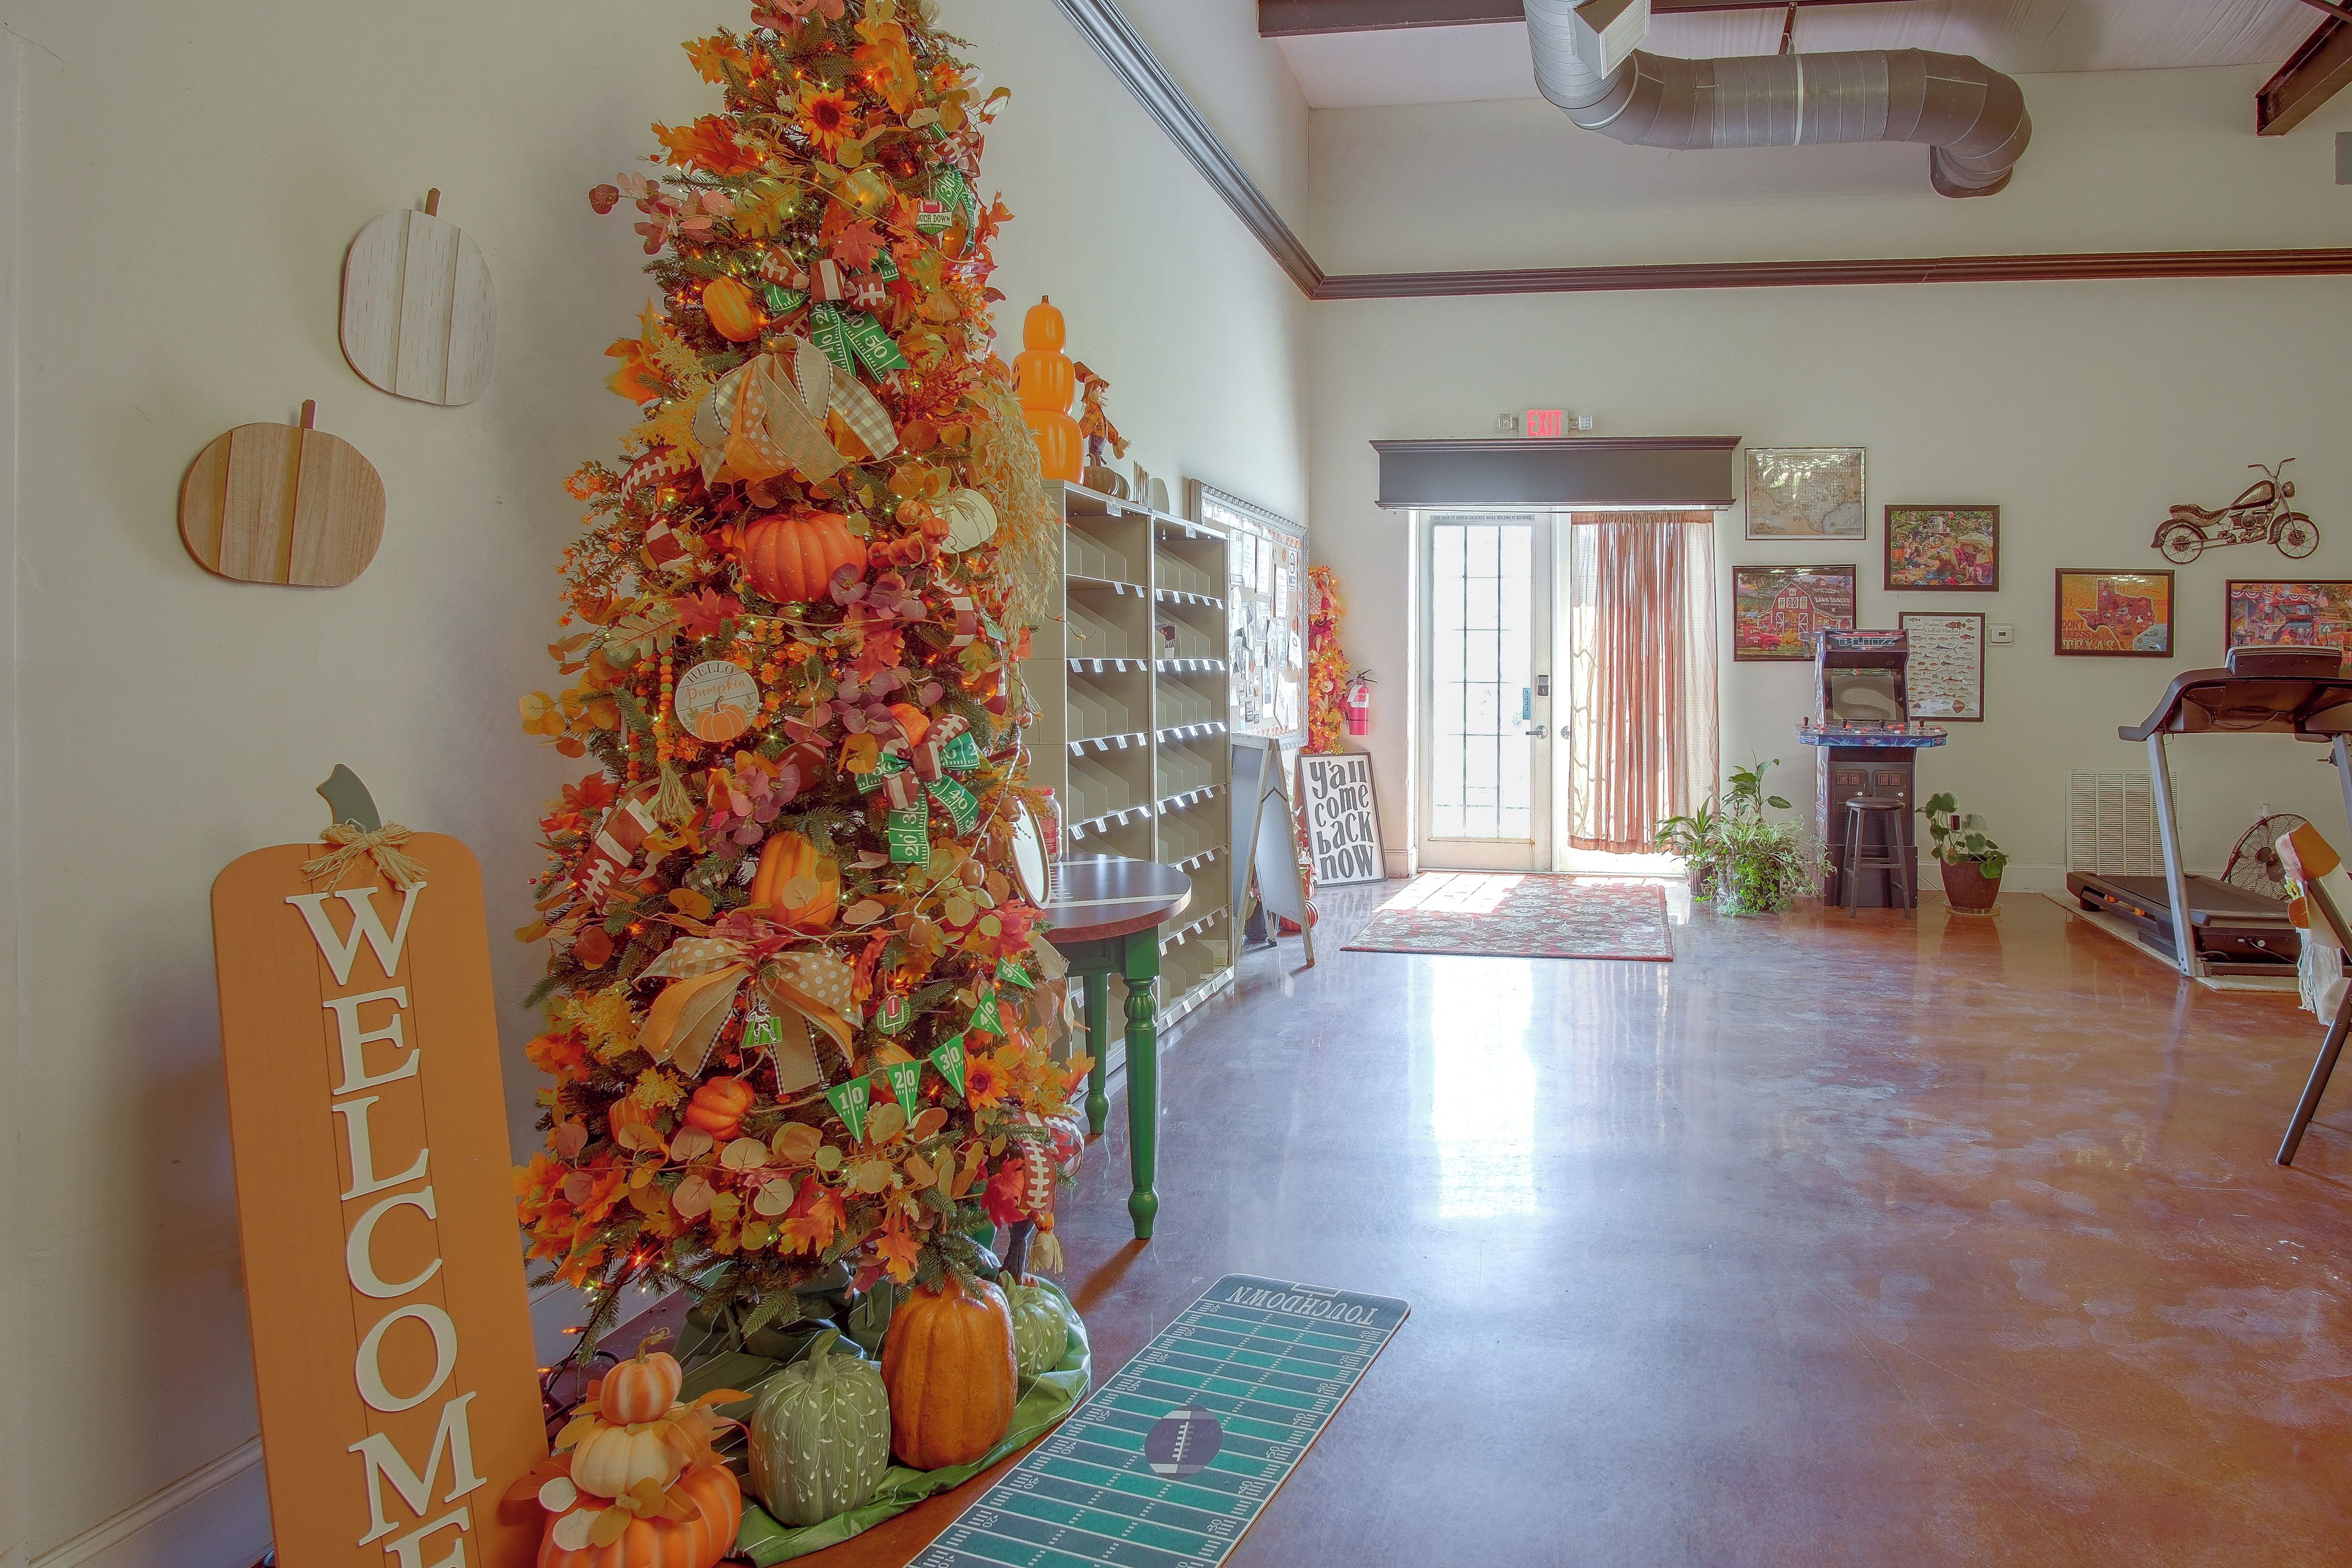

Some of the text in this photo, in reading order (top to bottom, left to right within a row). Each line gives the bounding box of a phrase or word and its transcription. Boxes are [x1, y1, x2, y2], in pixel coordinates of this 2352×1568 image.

[917, 214, 950, 223] OUCH DOWN
[821, 334, 835, 354] 10
[865, 335, 888, 358] 50
[1527, 410, 1562, 437] EXIT
[2062, 619, 2084, 629] DON'T
[1839, 637, 1896, 647] BLITZ
[2062, 639, 2115, 649] TEXAS
[686, 663, 734, 683] HELLO
[682, 676, 747, 709] Pumpkin
[949, 790, 967, 810] 40
[1315, 785, 1368, 827] come
[903, 835, 919, 856] 20
[979, 1001, 995, 1026] 40
[940, 1047, 960, 1069] 30
[894, 1069, 916, 1090] 20
[838, 1087, 864, 1105] 10
[1226, 1286, 1379, 1326] TOUCHDOWN
[1185, 1328, 1196, 1336] 20
[1360, 1330, 1370, 1339] 10
[1158, 1353, 1169, 1362] 30
[1340, 1355, 1350, 1365] 20
[1126, 1379, 1141, 1392] 40
[1317, 1382, 1327, 1393] 30
[1096, 1410, 1110, 1421] 50
[1293, 1413, 1306, 1425] 40
[1061, 1442, 1076, 1454] 40
[1267, 1446, 1280, 1459] 50
[1024, 1477, 1039, 1489] 30
[1238, 1480, 1253, 1494] 40
[983, 1515, 998, 1528] 20
[1208, 1519, 1222, 1532] 30
